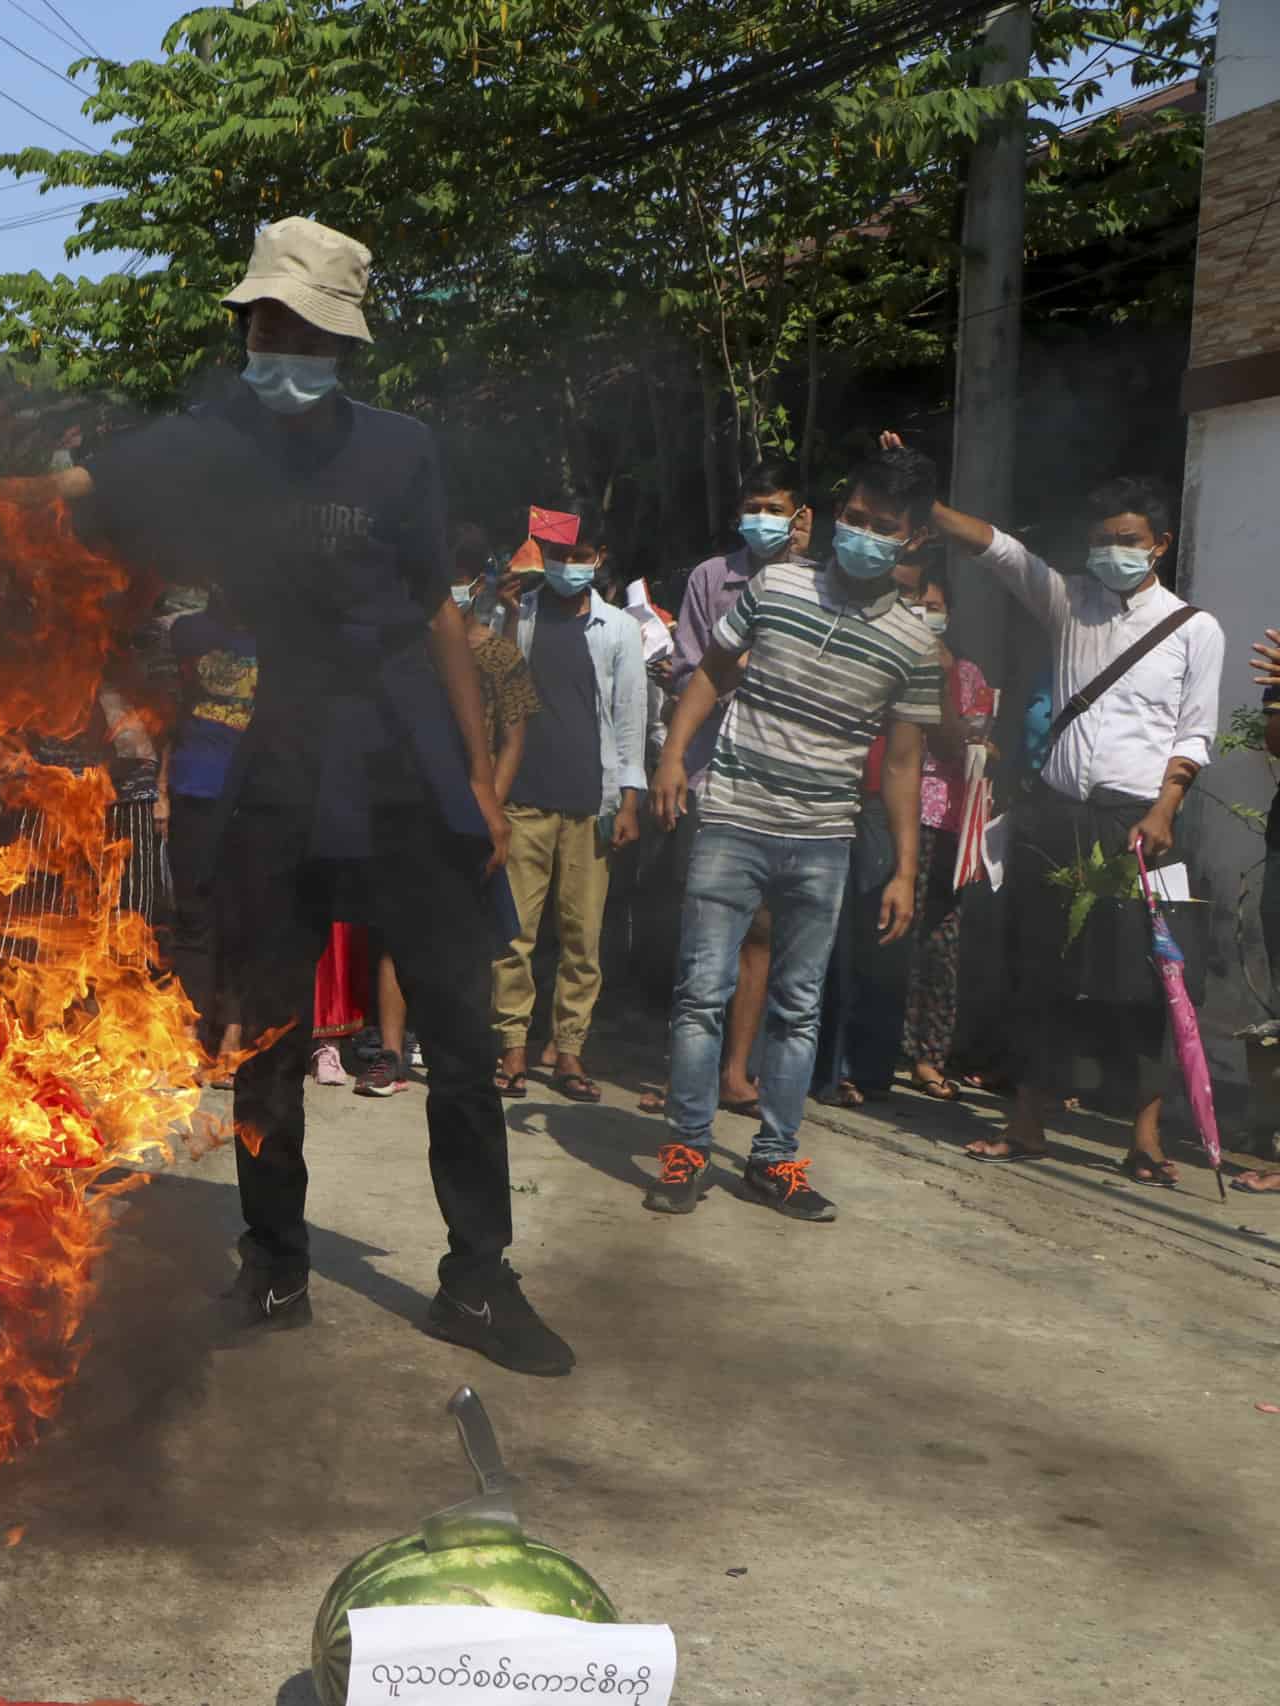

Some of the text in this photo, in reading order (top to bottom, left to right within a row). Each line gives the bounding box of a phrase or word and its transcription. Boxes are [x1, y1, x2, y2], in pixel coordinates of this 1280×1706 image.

[371, 1653, 651, 1706] လူသတ်စစ်ကောင်စီကို
